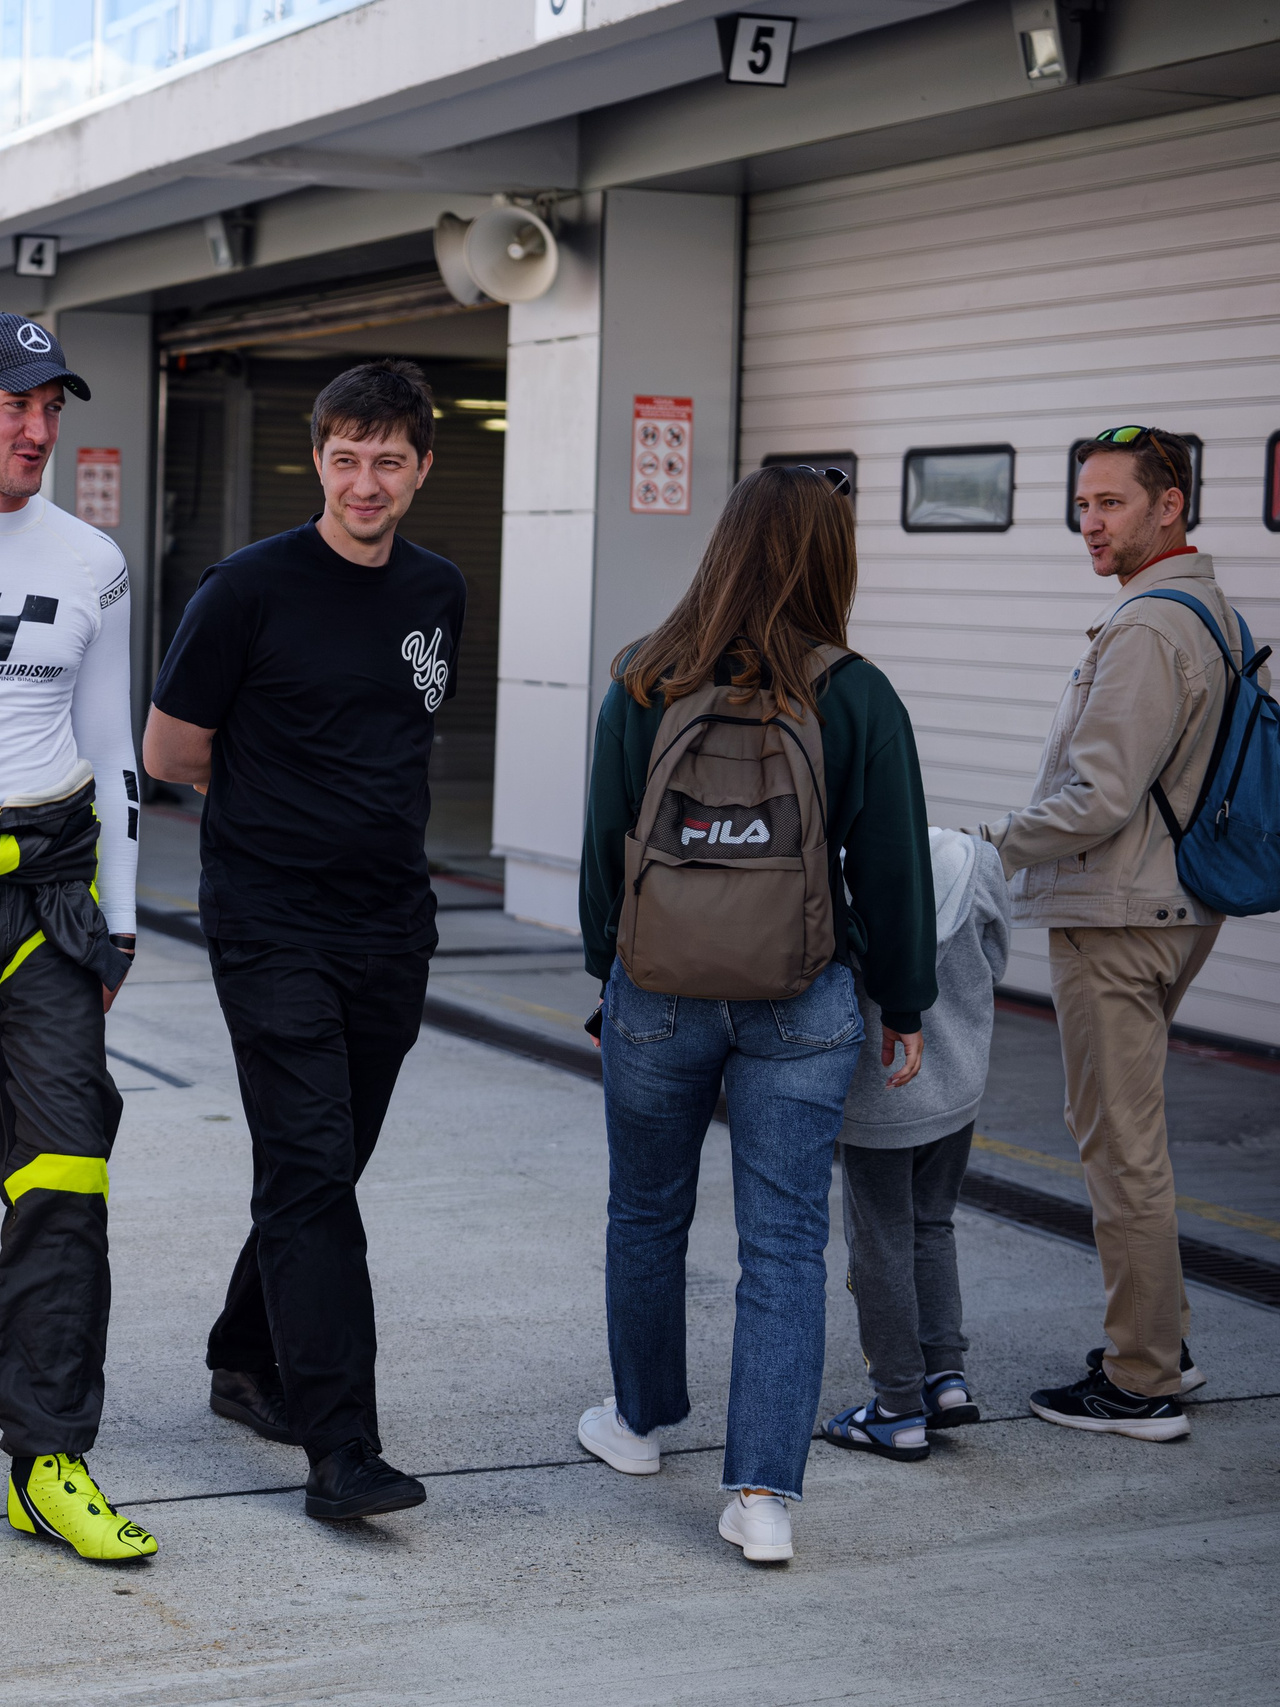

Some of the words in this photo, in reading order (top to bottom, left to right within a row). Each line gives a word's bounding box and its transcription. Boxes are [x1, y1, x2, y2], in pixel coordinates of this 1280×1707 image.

[747, 25, 775, 75] 5
[29, 242, 45, 269] 4
[681, 817, 770, 846] FILA
